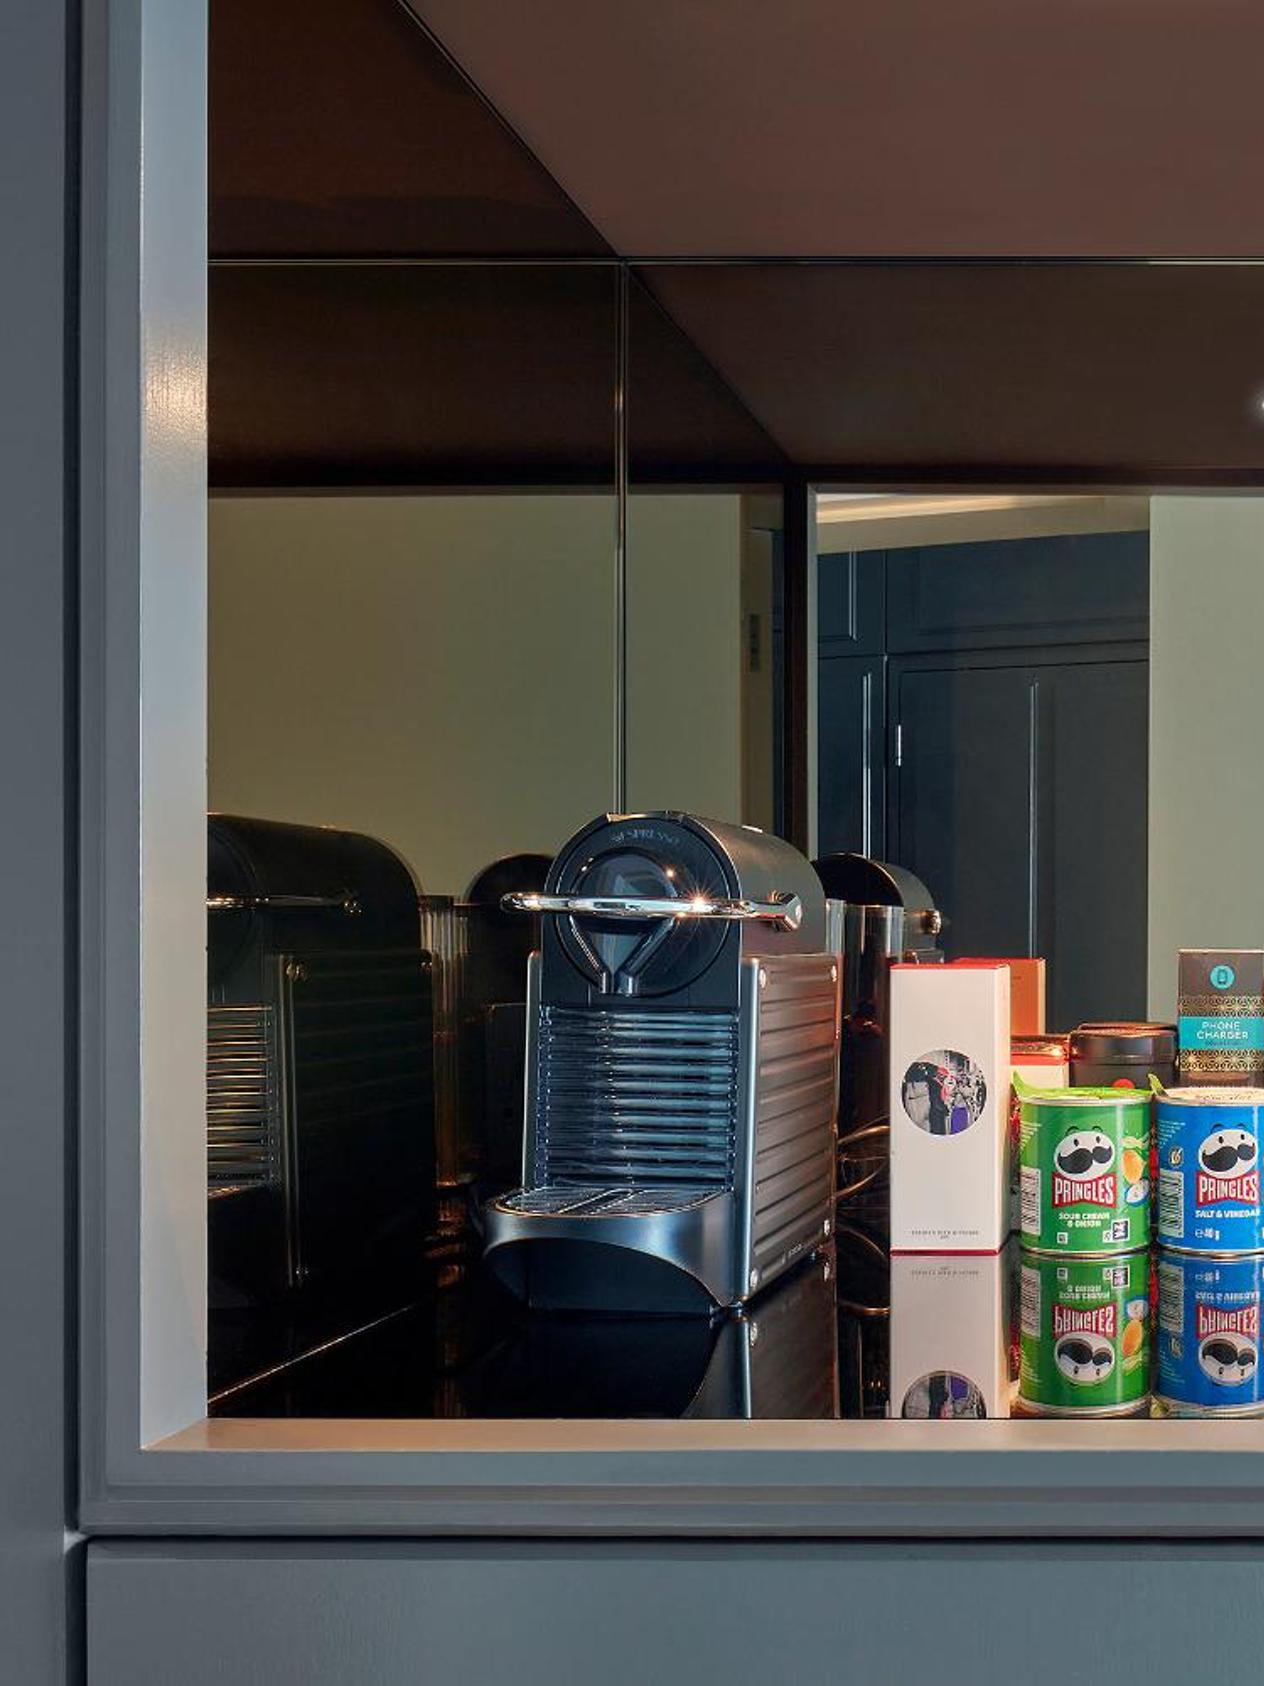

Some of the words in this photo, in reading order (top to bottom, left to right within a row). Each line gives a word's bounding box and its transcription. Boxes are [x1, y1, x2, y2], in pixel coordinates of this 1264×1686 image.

[1201, 1021, 1241, 1031] PHONE
[1196, 1031, 1249, 1040] CHARGER
[1054, 1176, 1115, 1205] PRINGLES
[1199, 1175, 1258, 1203] PRINGLES
[1059, 1212, 1081, 1220] SOUR
[1082, 1212, 1110, 1220] CREAM
[1195, 1210, 1214, 1218] SALT
[1223, 1208, 1260, 1218] VINEGAR
[1075, 1220, 1102, 1228] ONION
